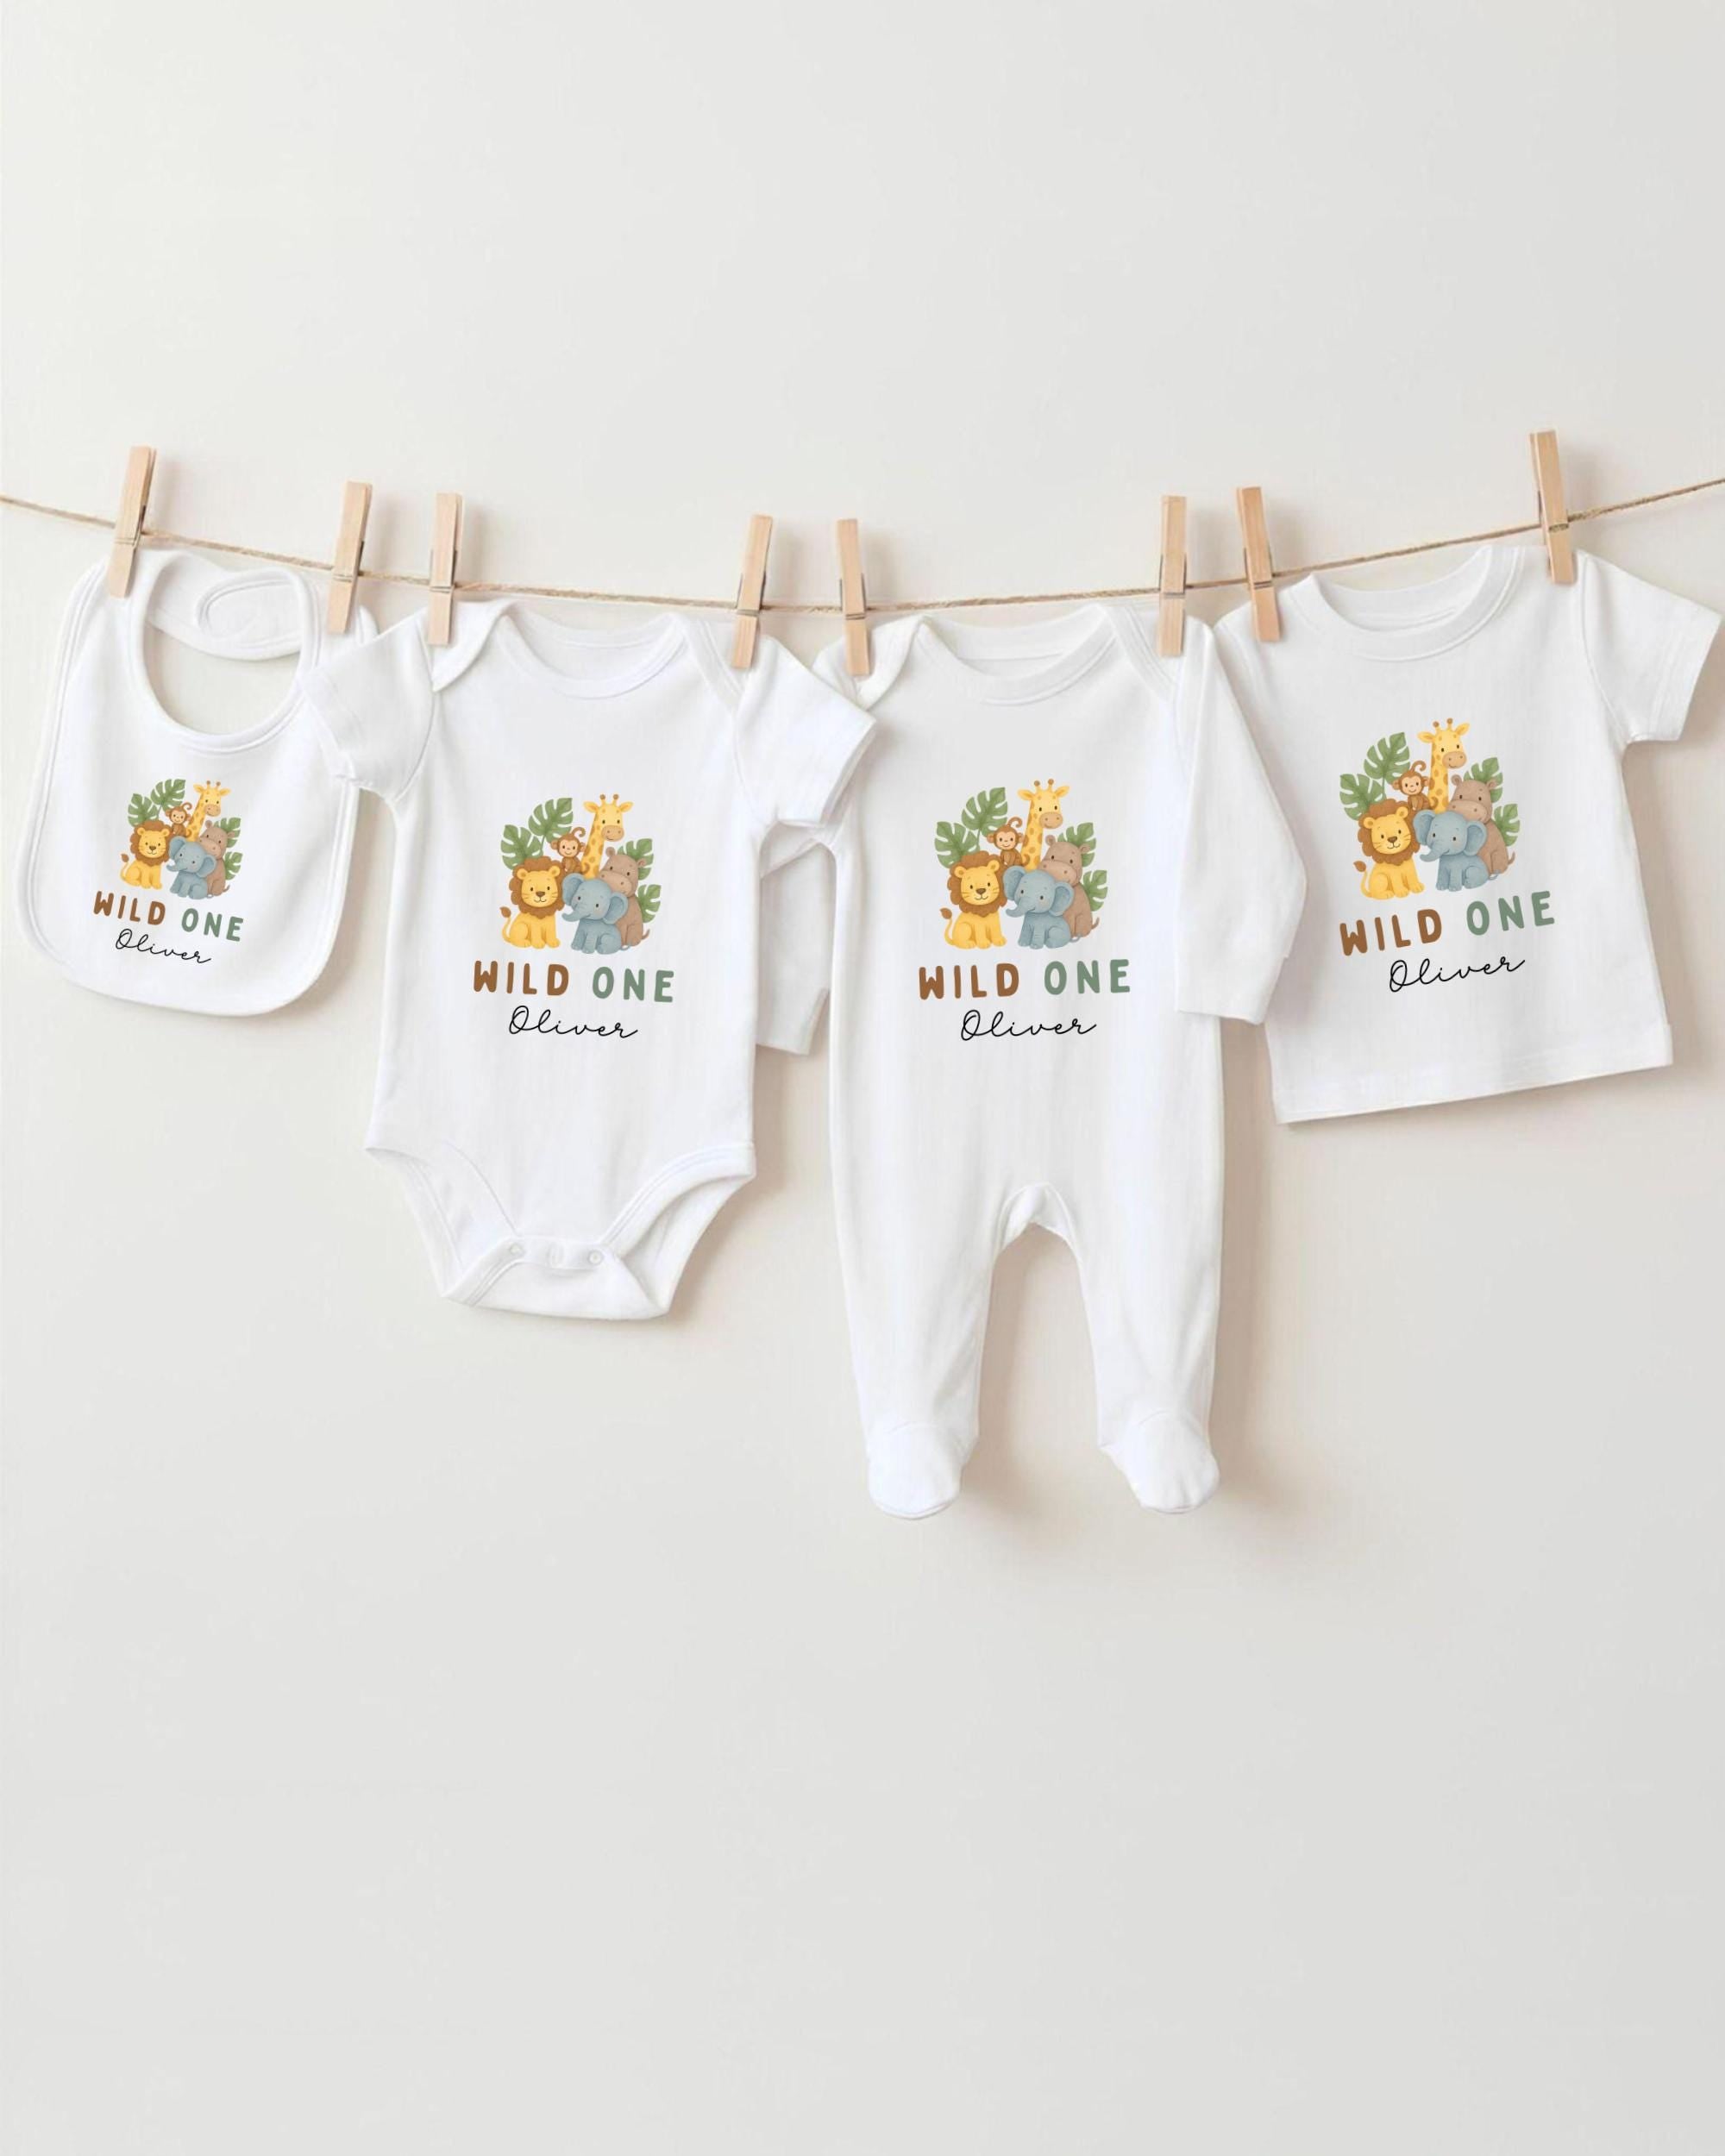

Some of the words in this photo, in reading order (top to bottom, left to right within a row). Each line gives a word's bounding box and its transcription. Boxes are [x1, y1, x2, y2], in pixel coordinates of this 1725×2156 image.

[93, 890, 166, 926] WILD
[181, 907, 244, 943] ONE
[1339, 908, 1443, 957] WILD
[1466, 890, 1555, 937] ONE
[115, 928, 212, 964] Oliver
[473, 960, 569, 996] WILD
[592, 966, 674, 1003] ONE
[918, 962, 1019, 1001] WILD
[1044, 958, 1131, 996] ONE
[1389, 956, 1526, 993] Oliver
[508, 1005, 639, 1039] Oliver
[960, 1008, 1098, 1042] Oliver
